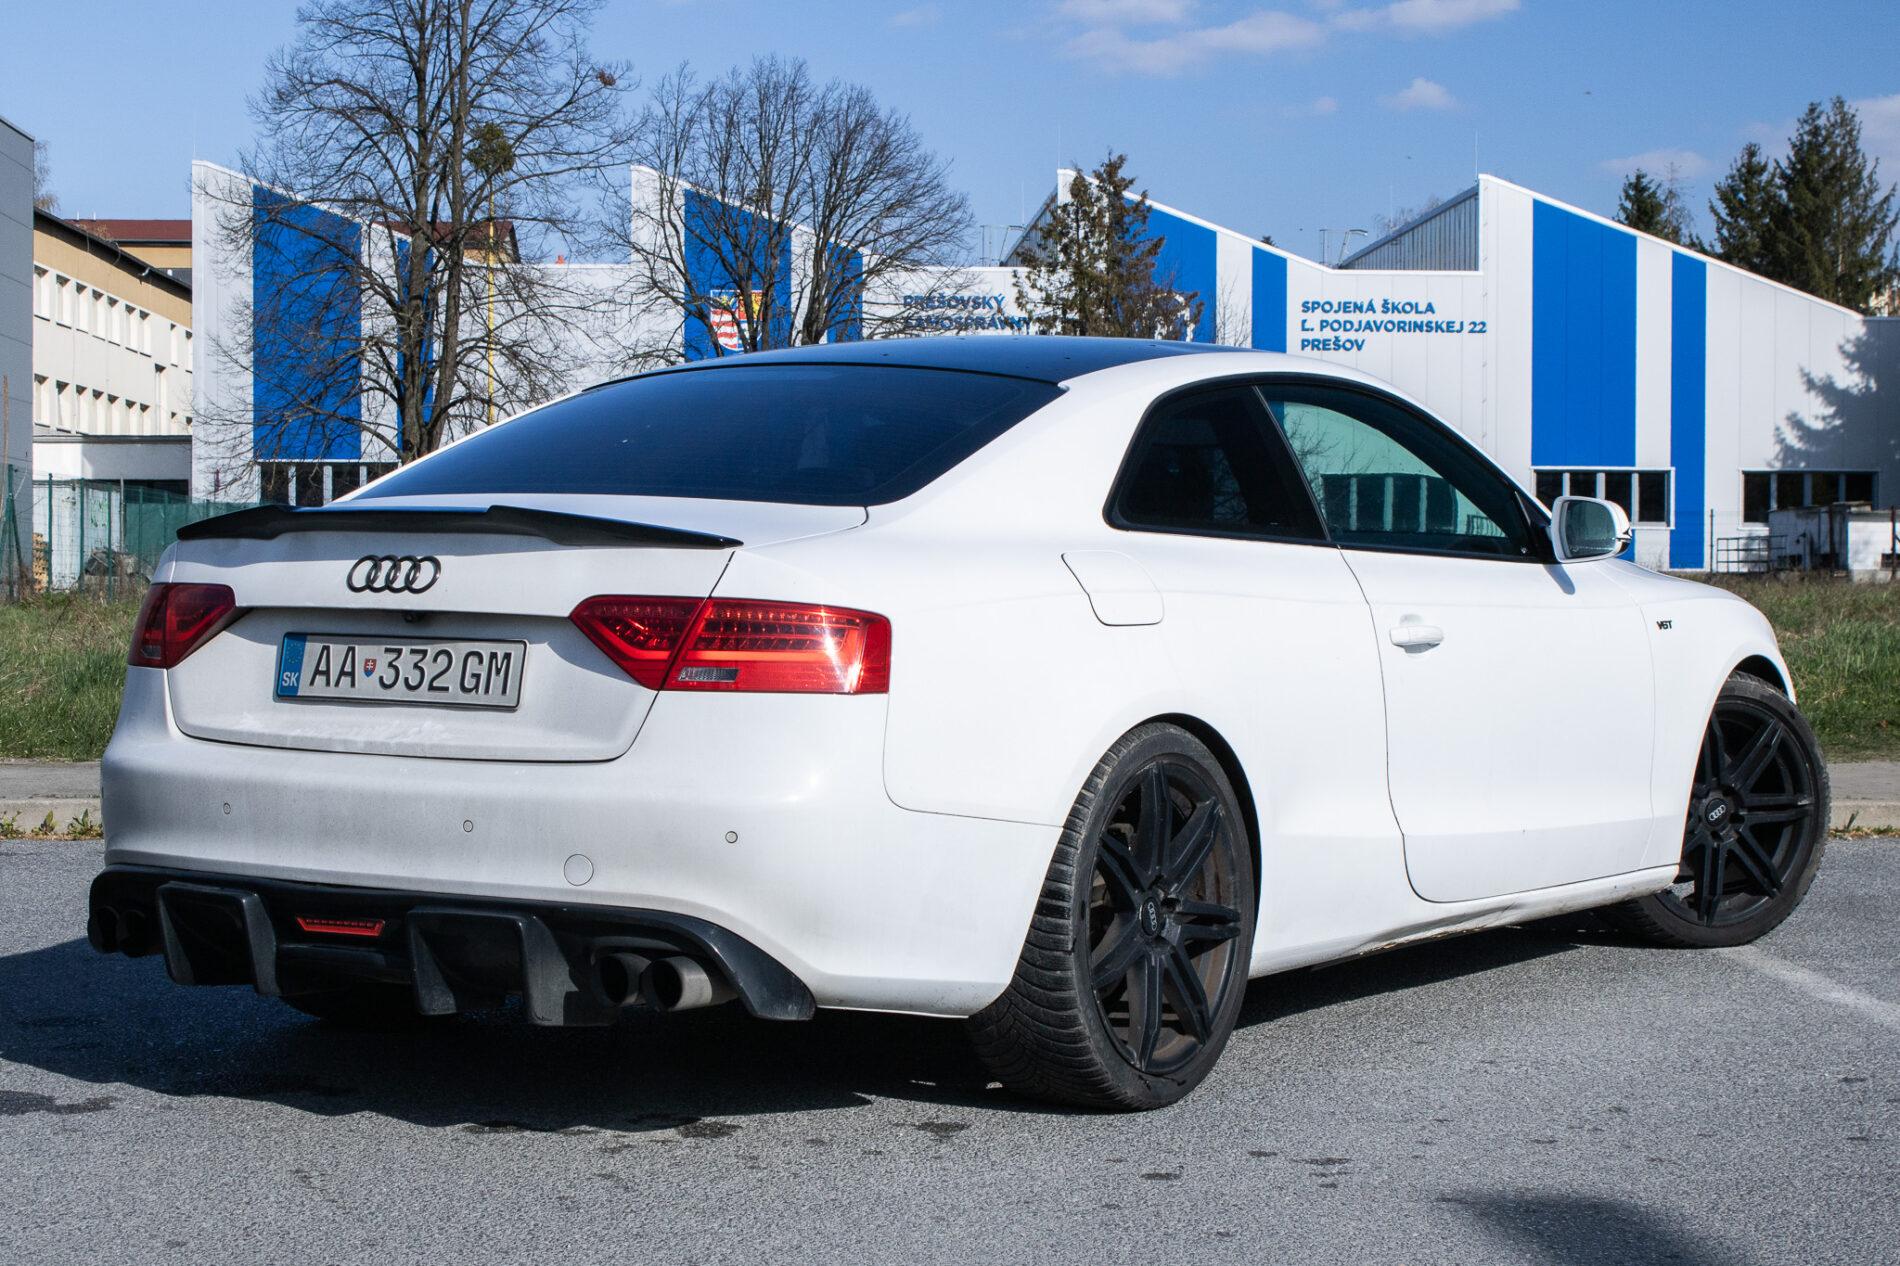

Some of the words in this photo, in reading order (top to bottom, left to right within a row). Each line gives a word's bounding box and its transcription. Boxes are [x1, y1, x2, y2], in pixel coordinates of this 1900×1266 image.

[1301, 299, 1377, 314] SPOJENÁ
[1381, 298, 1436, 315] ŠKOLA
[1319, 319, 1464, 334] PODJAVORINSKEJ
[1468, 321, 1488, 334] 22
[1301, 336, 1366, 352] PREŠOV
[281, 670, 300, 688] SK
